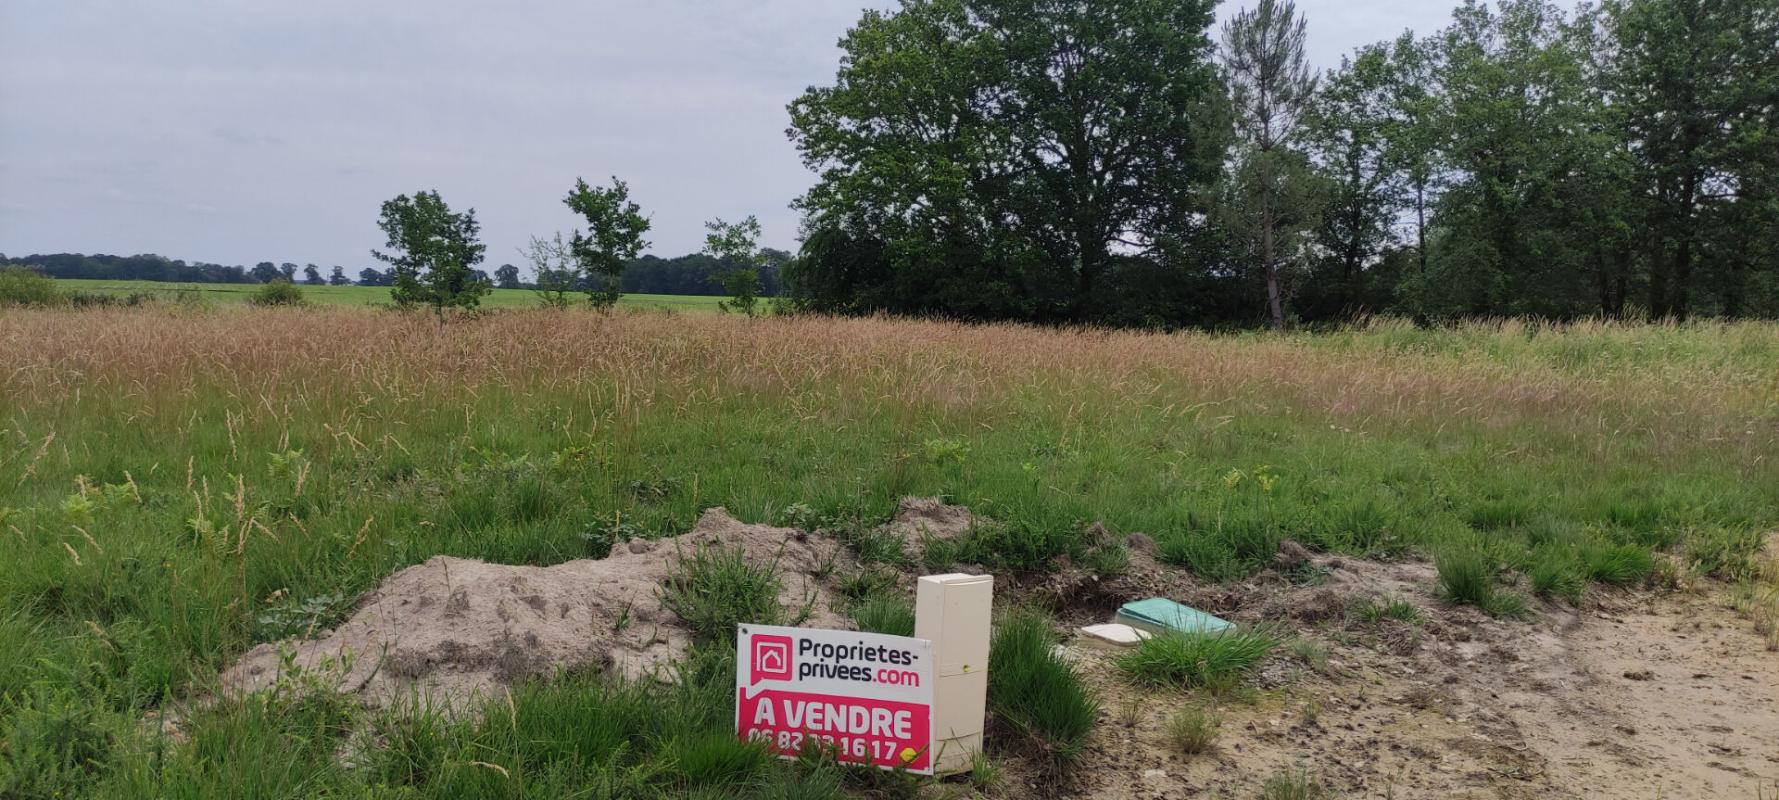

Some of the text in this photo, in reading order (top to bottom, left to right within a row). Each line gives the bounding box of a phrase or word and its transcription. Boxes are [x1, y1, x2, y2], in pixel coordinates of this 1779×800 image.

[799, 638, 919, 665] Proprietes-
[799, 659, 920, 687] privees.com
[754, 697, 912, 739] A VENDRE
[840, 737, 866, 757] 16
[872, 740, 897, 760] 17
